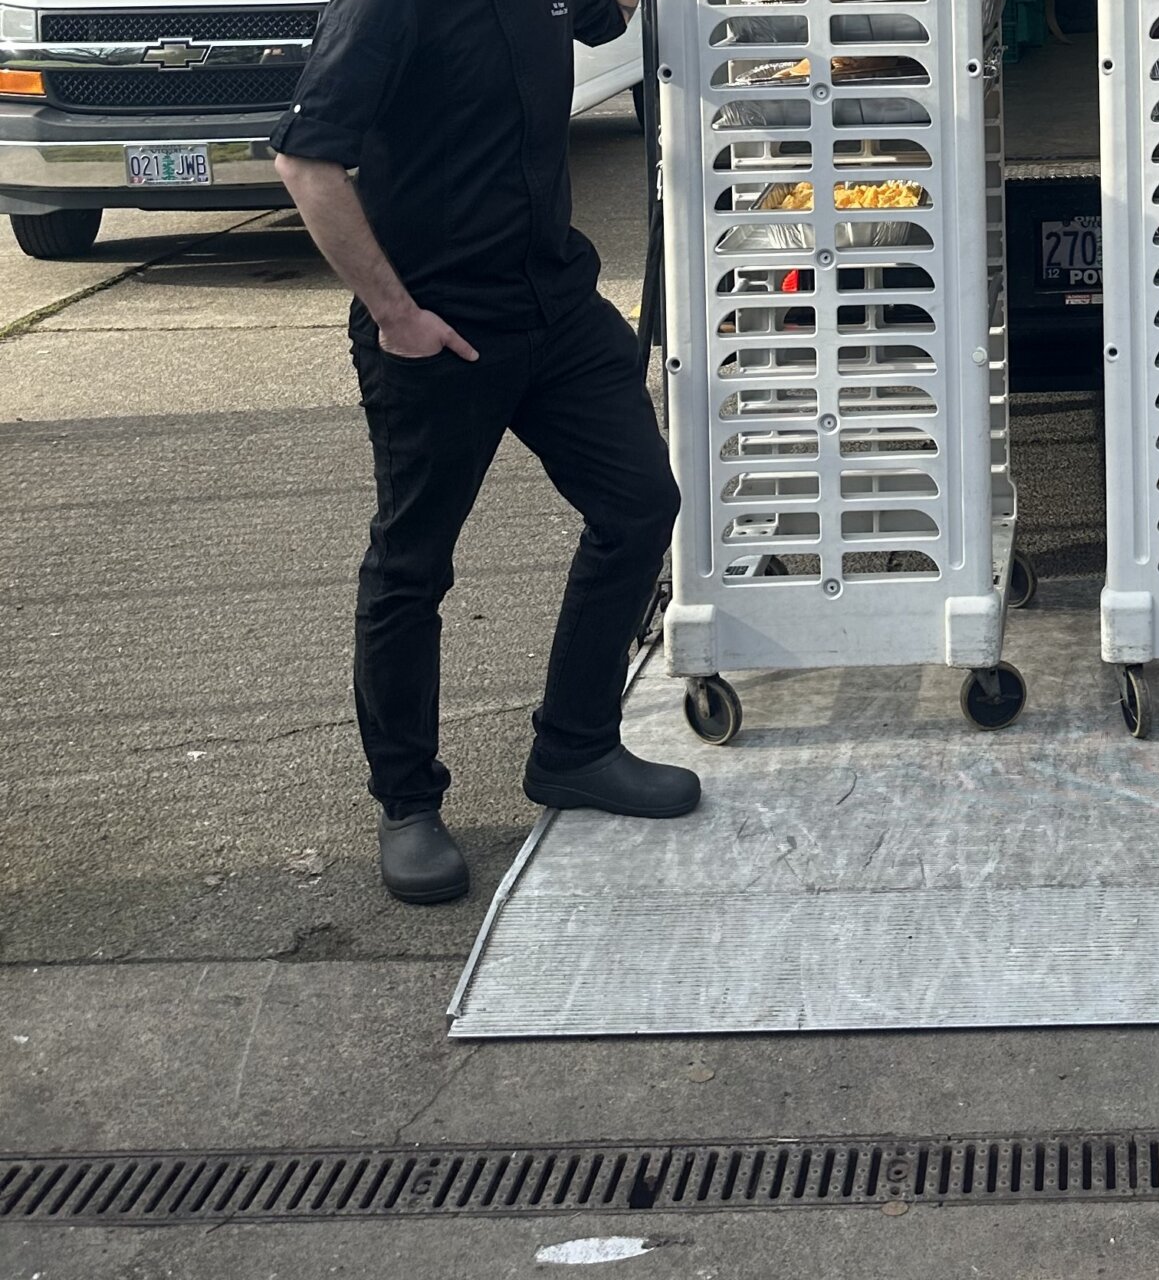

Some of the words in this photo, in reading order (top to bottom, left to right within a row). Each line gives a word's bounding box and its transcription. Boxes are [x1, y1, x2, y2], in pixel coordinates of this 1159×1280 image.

[130, 155, 160, 176] 021
[175, 154, 207, 176] JWB
[1045, 230, 1097, 268] 270
[1069, 269, 1103, 285] PO
